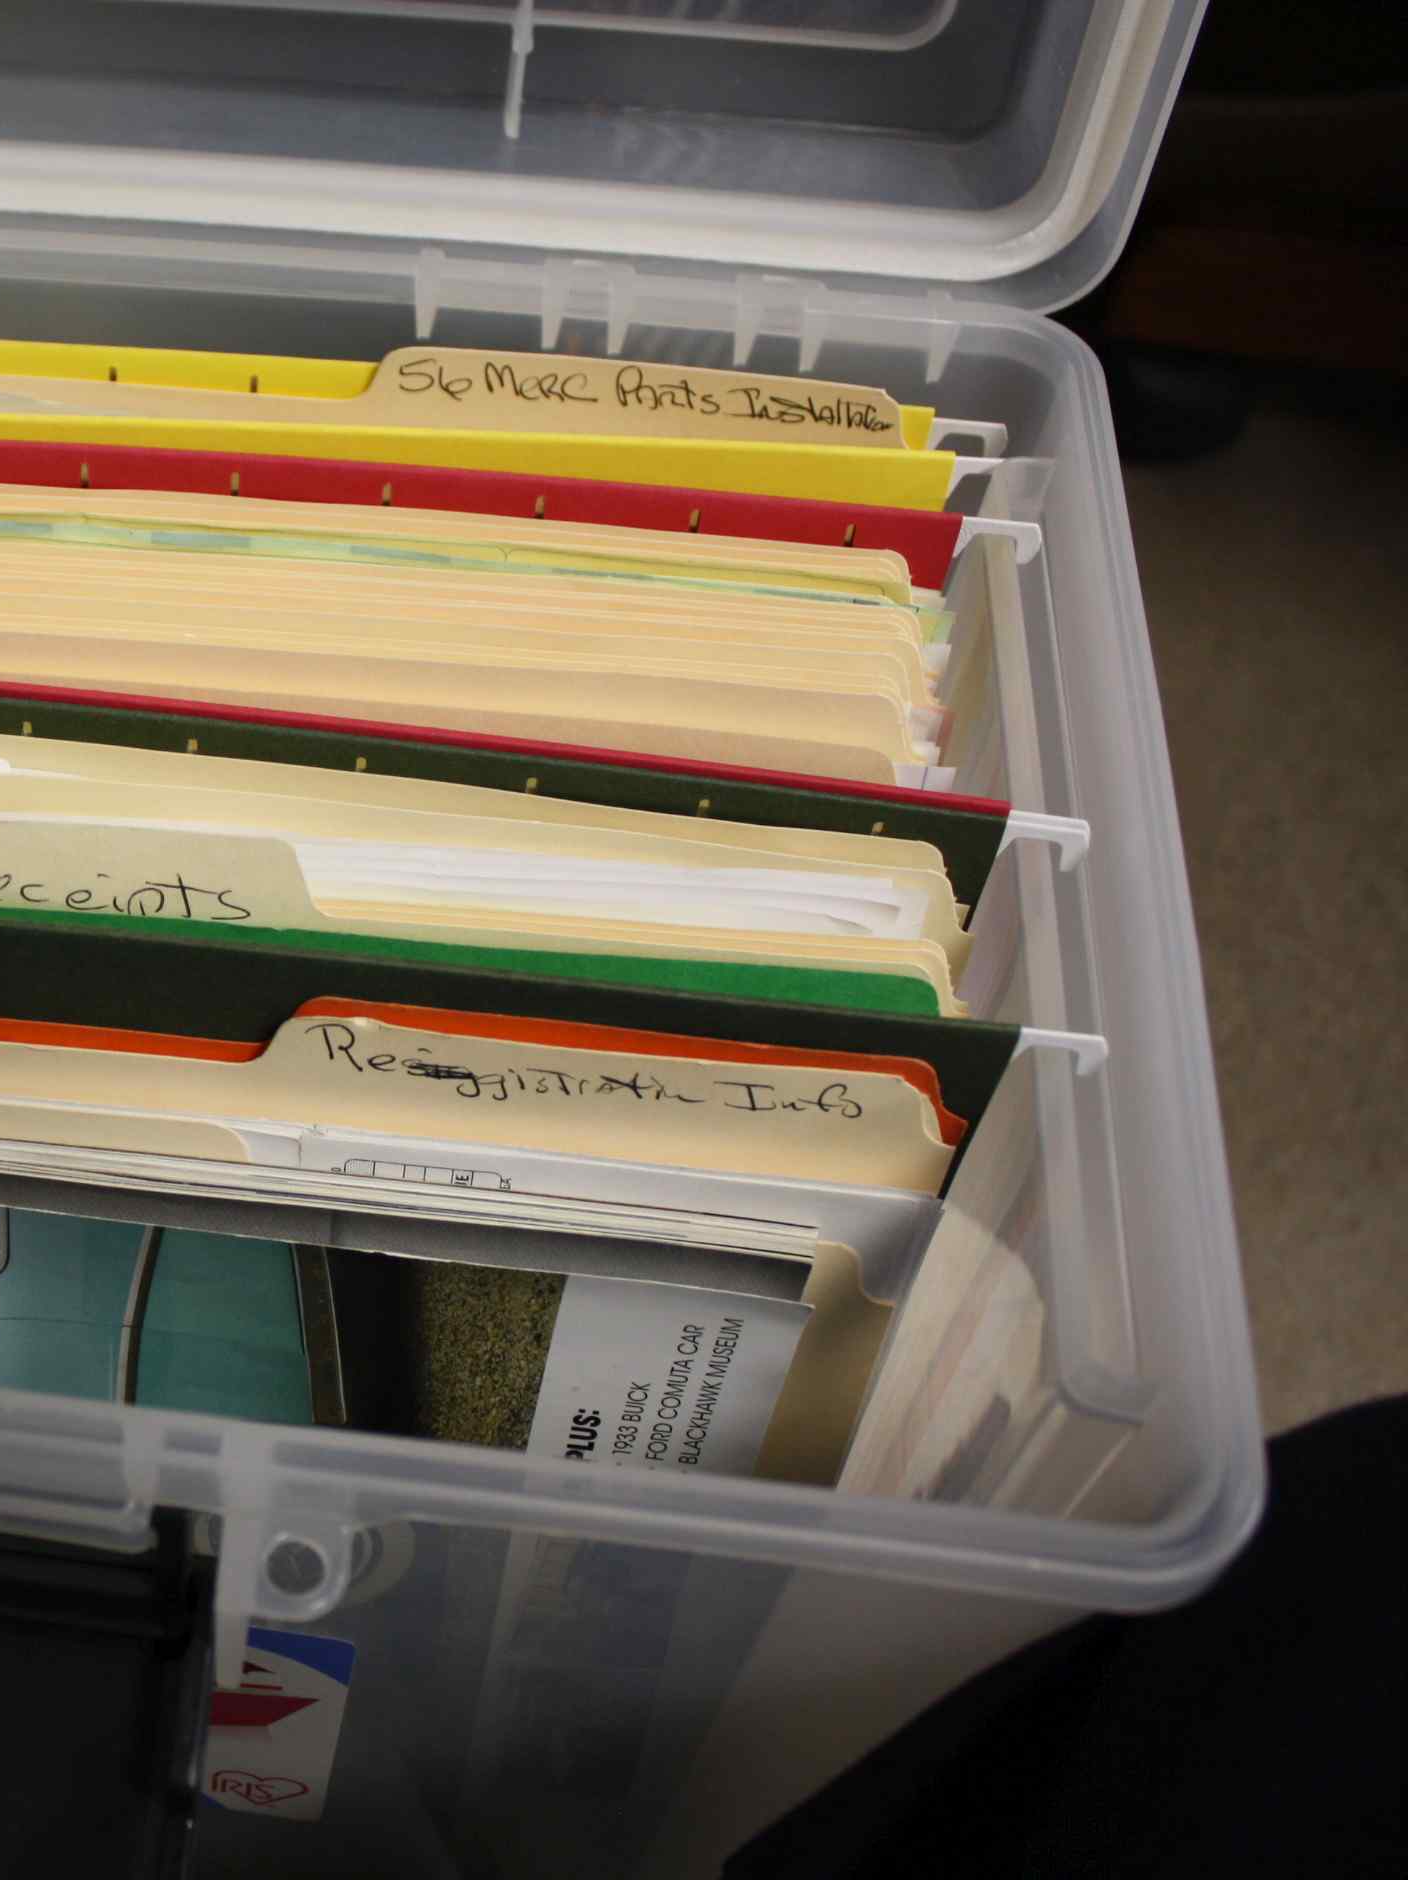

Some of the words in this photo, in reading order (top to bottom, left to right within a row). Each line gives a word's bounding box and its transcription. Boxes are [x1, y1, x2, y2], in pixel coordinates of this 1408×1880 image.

[399, 358, 472, 400] 56
[677, 1323, 705, 1356] CAR
[621, 1381, 651, 1422] BUICK
[658, 1359, 694, 1420] COMUTA
[678, 1380, 723, 1465] BLACKHAWK
[705, 1317, 745, 1378] MUSEUM
[565, 1408, 602, 1461] PLUS:
[612, 1425, 639, 1455] 1933
[645, 1422, 673, 1461] FORD
